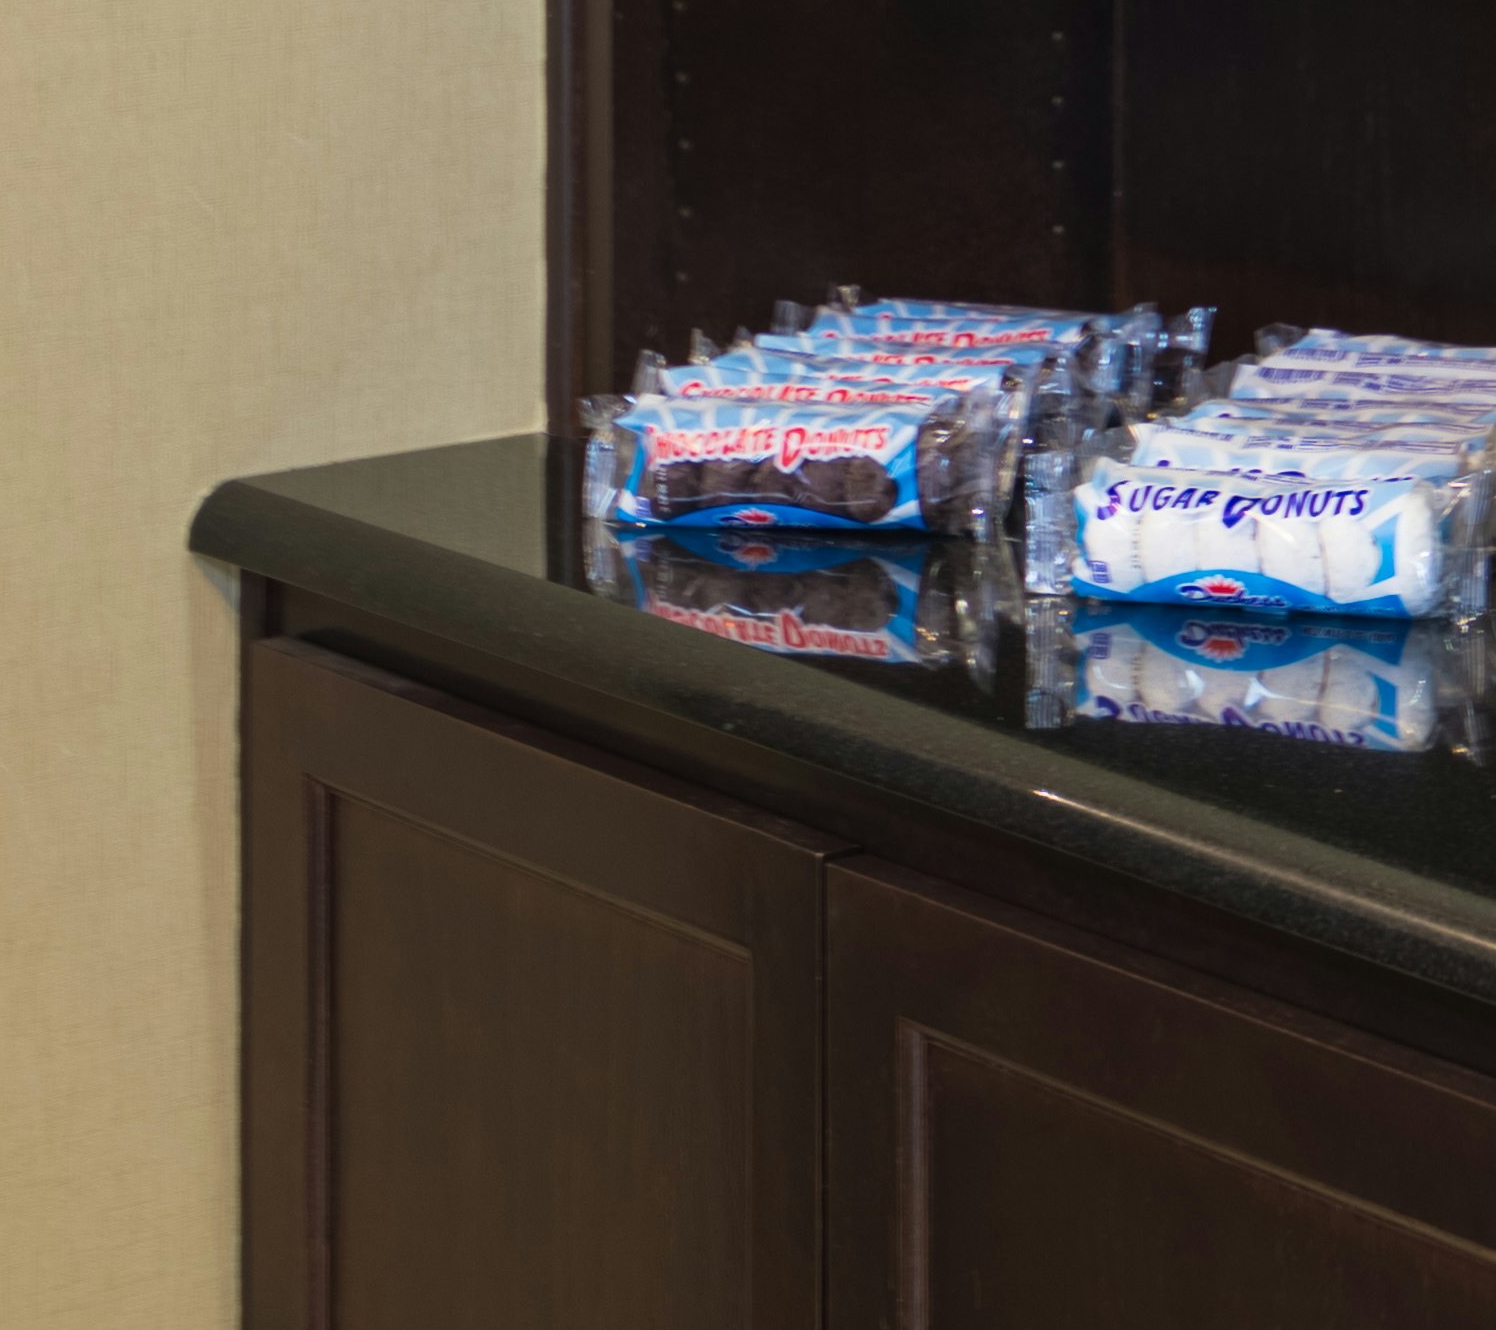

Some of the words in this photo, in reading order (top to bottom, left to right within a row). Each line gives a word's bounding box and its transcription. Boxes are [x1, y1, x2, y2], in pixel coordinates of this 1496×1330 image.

[645, 424, 776, 469] CHOCOLATE
[778, 427, 888, 472] DONUTS
[1098, 479, 1218, 521] SUGAR
[1223, 487, 1368, 529] DONUTS
